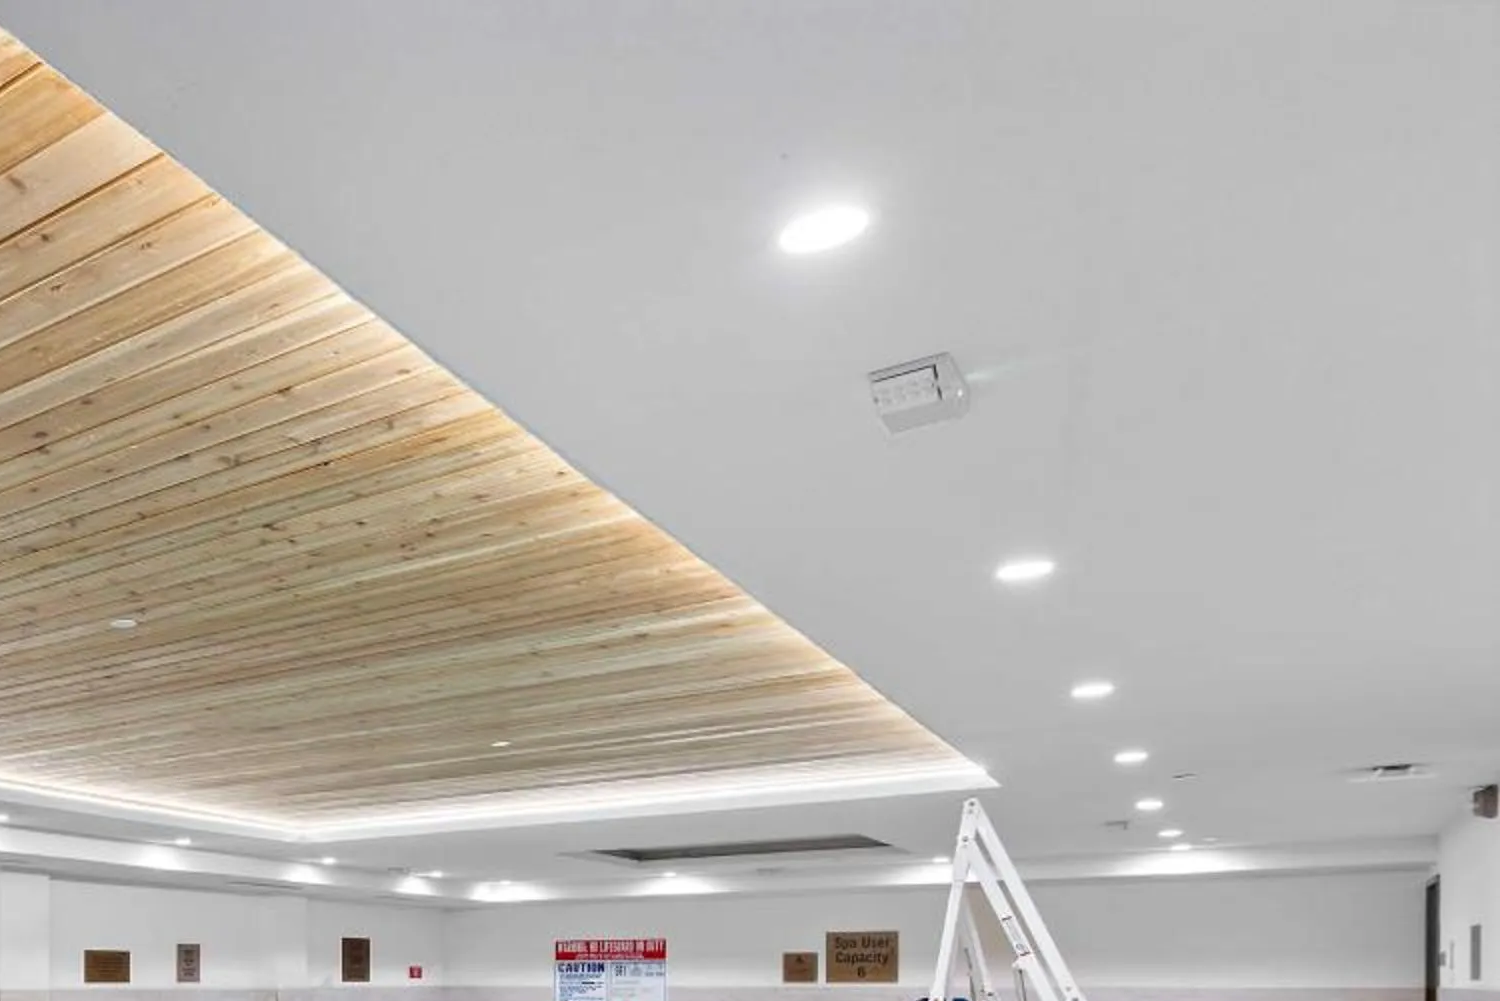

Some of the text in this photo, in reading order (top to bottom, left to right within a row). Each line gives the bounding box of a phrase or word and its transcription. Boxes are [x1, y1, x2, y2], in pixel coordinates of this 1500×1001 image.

[835, 935, 890, 950] Spa User
[835, 951, 889, 966] Capacity
[558, 962, 605, 973] CAUTION
